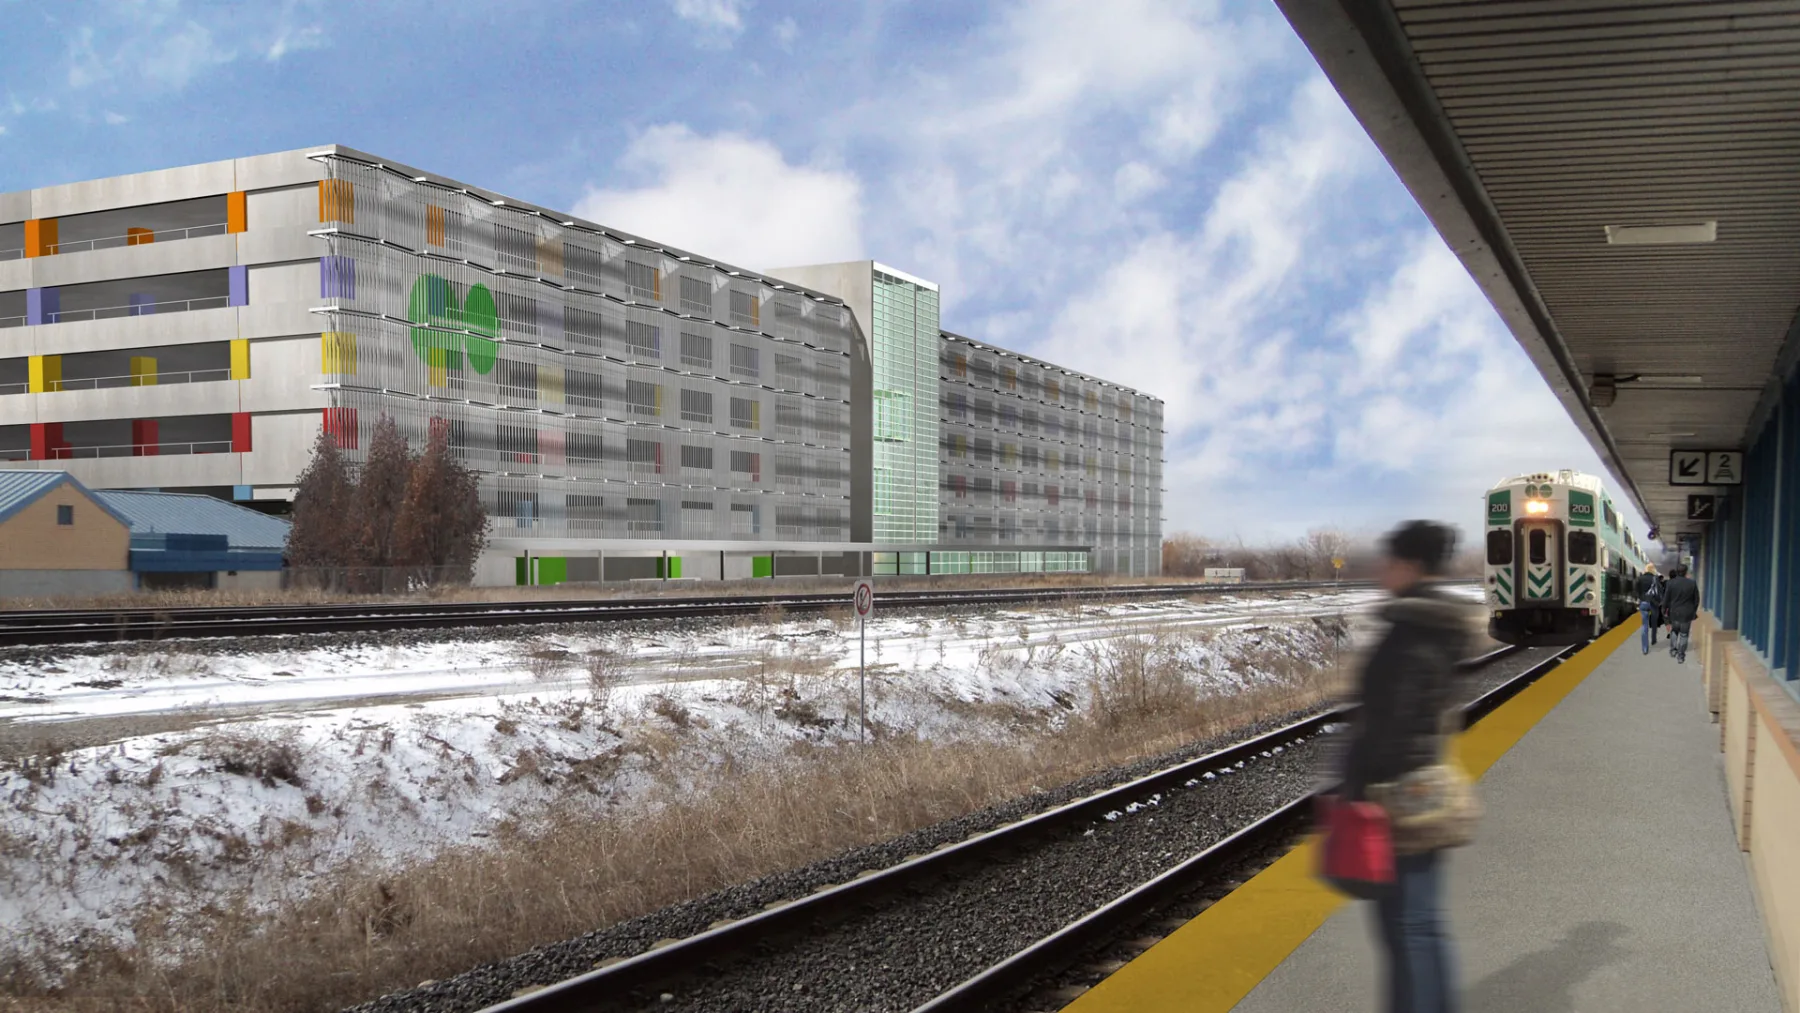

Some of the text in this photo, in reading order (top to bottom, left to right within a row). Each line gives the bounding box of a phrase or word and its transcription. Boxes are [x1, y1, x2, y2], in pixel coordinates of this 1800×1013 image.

[1719, 453, 1730, 468] 2
[1491, 503, 1508, 513] 200
[1572, 503, 1591, 514] 200
